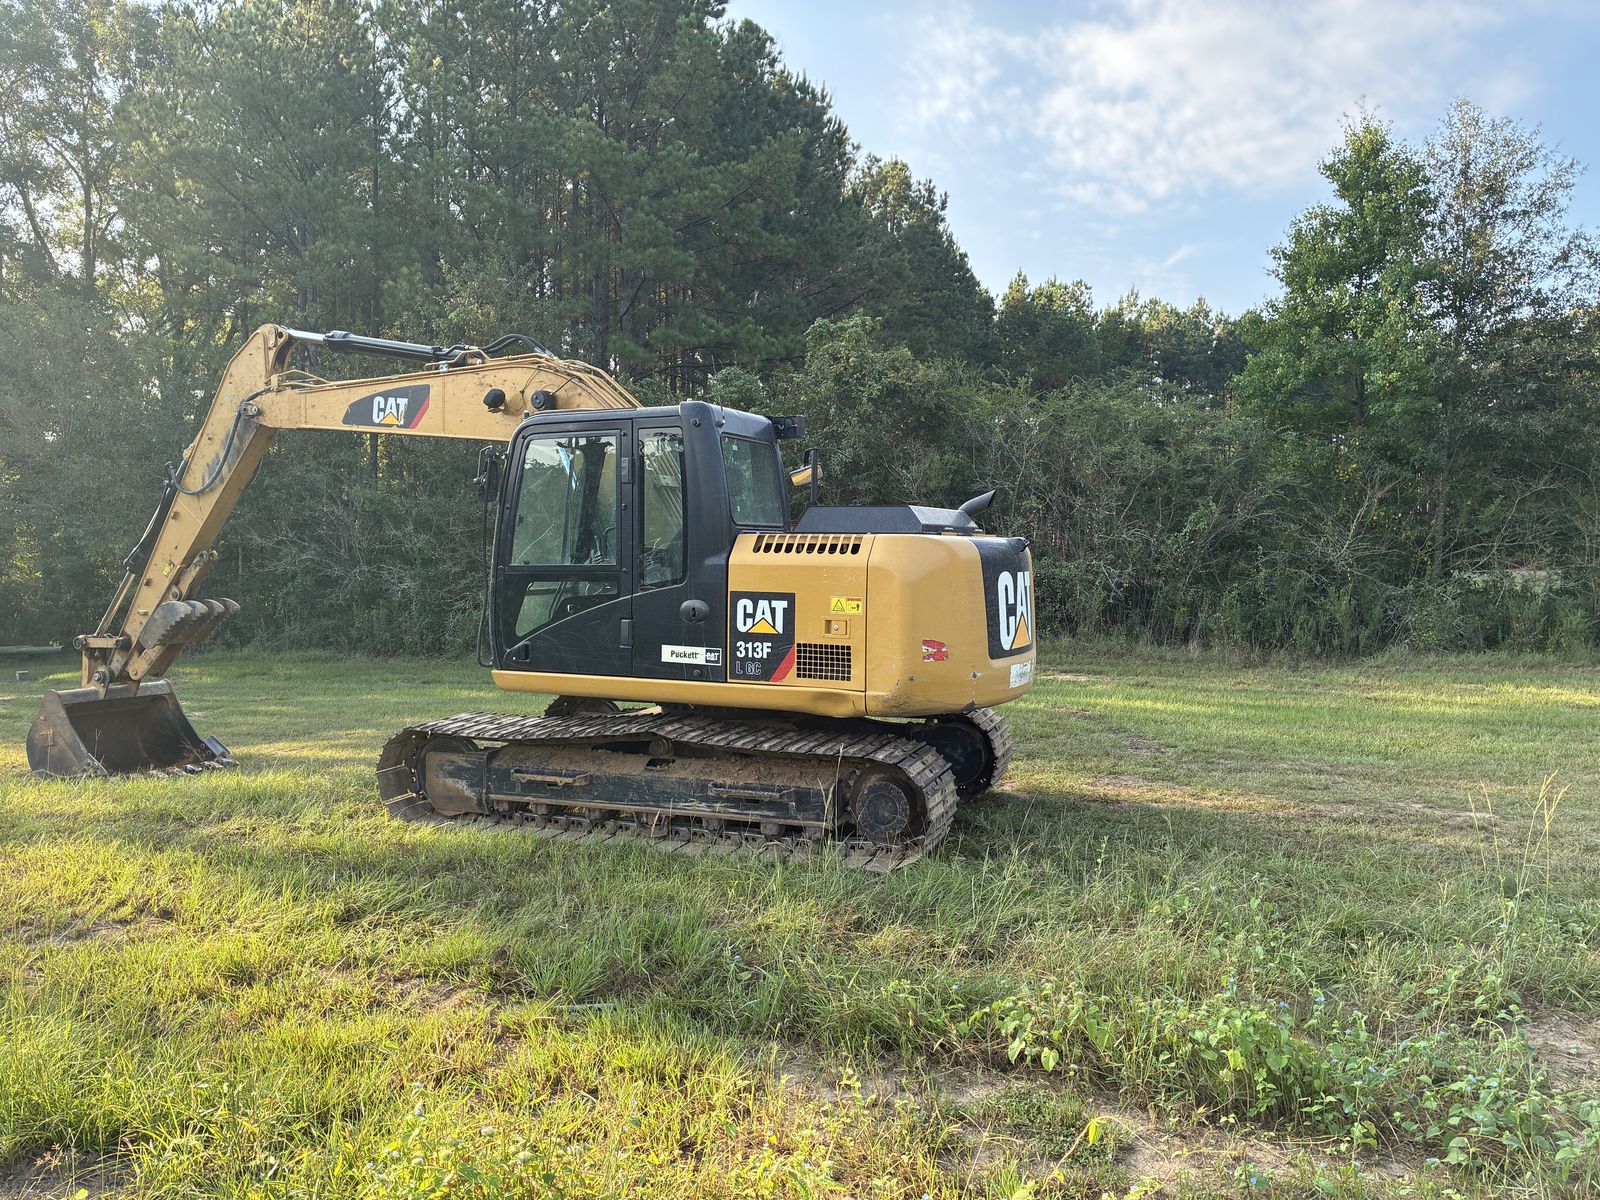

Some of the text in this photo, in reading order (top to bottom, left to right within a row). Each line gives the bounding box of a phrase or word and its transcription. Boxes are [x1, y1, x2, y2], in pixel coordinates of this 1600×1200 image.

[372, 396, 409, 426] CAT
[736, 598, 788, 634] CAT
[998, 571, 1032, 650] CAT
[670, 650, 698, 659] Puckett
[736, 641, 772, 659] 313F
[735, 661, 762, 675] L GC
